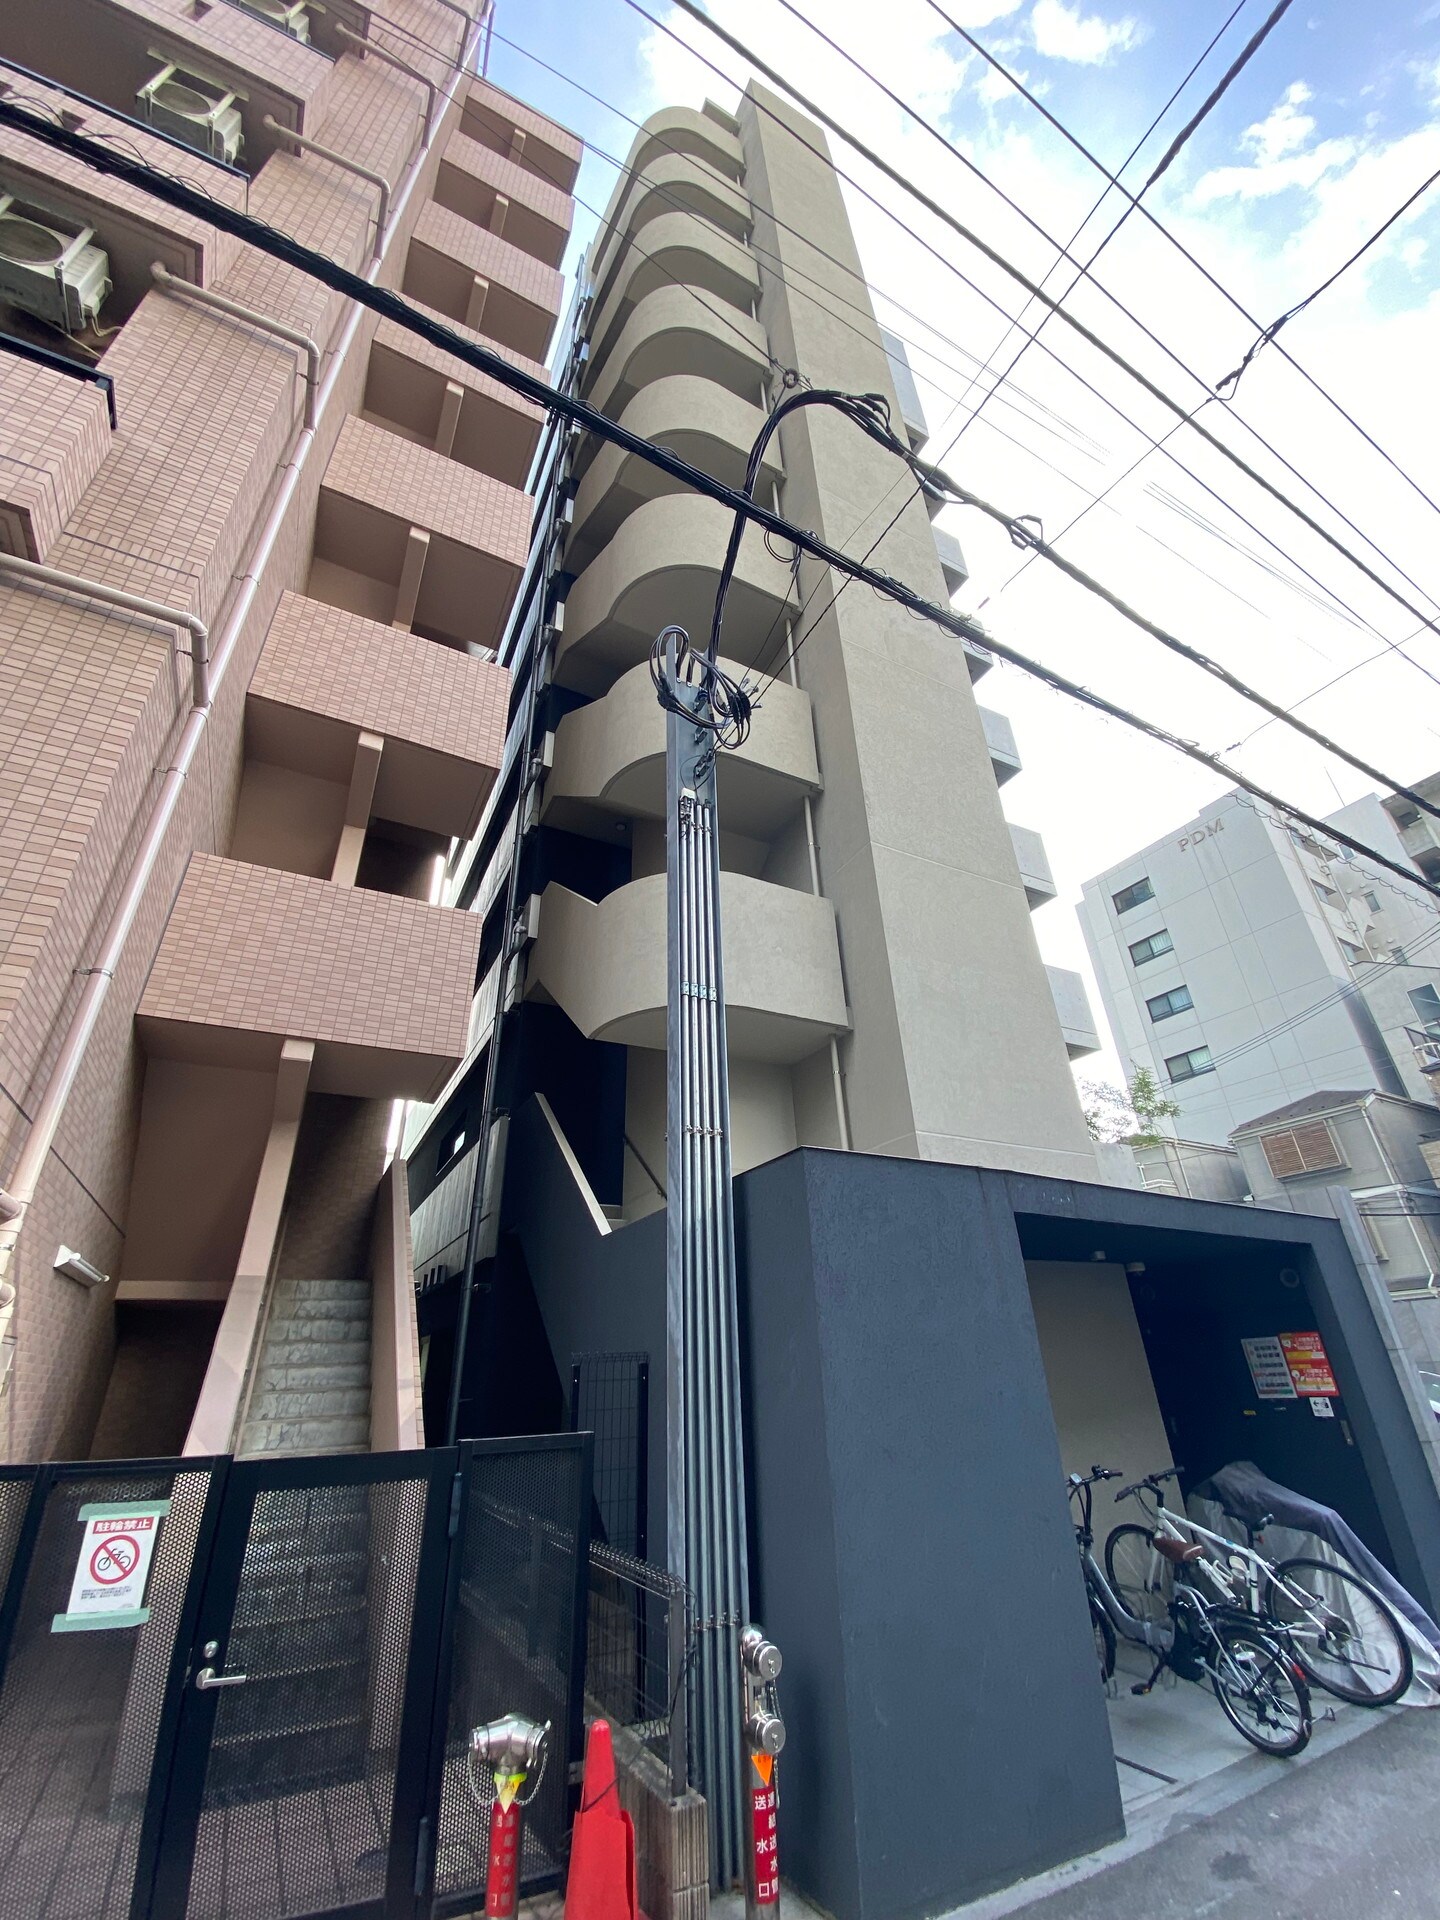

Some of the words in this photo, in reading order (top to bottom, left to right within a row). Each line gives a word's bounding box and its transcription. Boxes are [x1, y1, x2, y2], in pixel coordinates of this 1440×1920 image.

[1178, 818, 1224, 852] PDM
[95, 1519, 151, 1533] 駐輪禁止
[754, 1794, 770, 1898] 送水口
